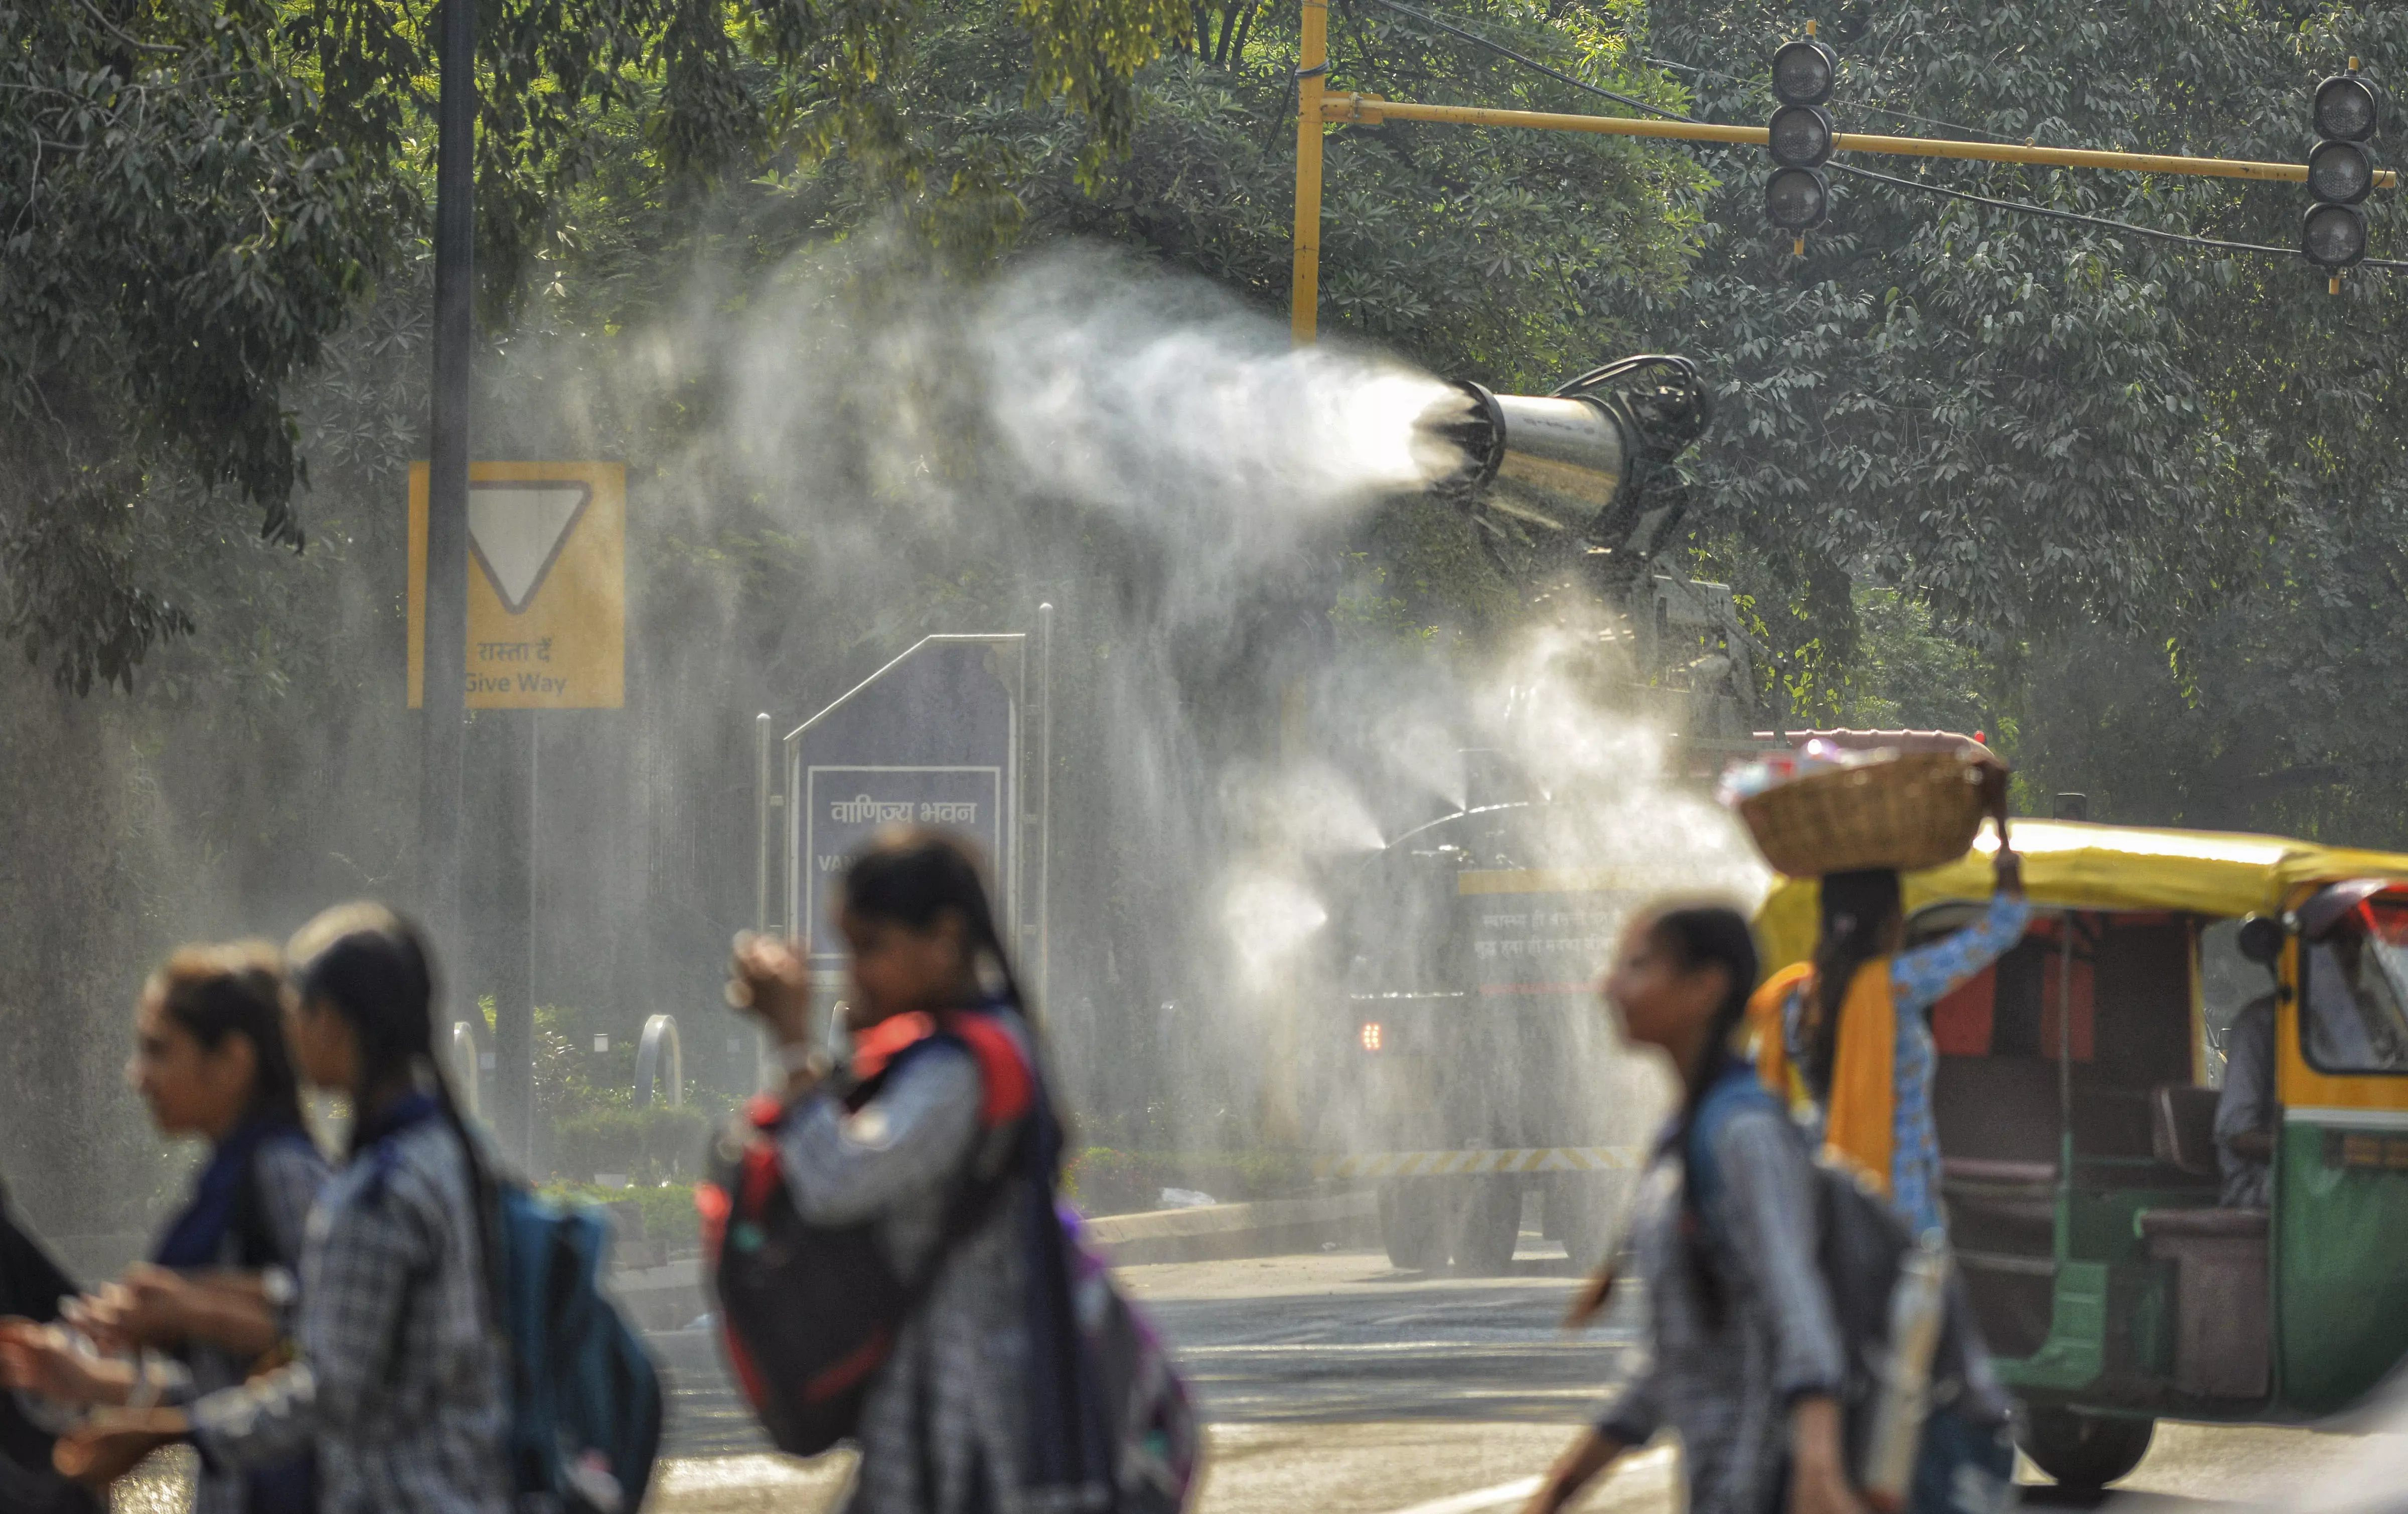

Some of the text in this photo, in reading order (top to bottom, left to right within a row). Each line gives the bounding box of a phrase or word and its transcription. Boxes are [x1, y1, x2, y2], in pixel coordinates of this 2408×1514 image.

[477, 641, 529, 661] रास्ता
[465, 672, 567, 697] Give Way
[830, 794, 978, 824] वाणिज्य भवन
